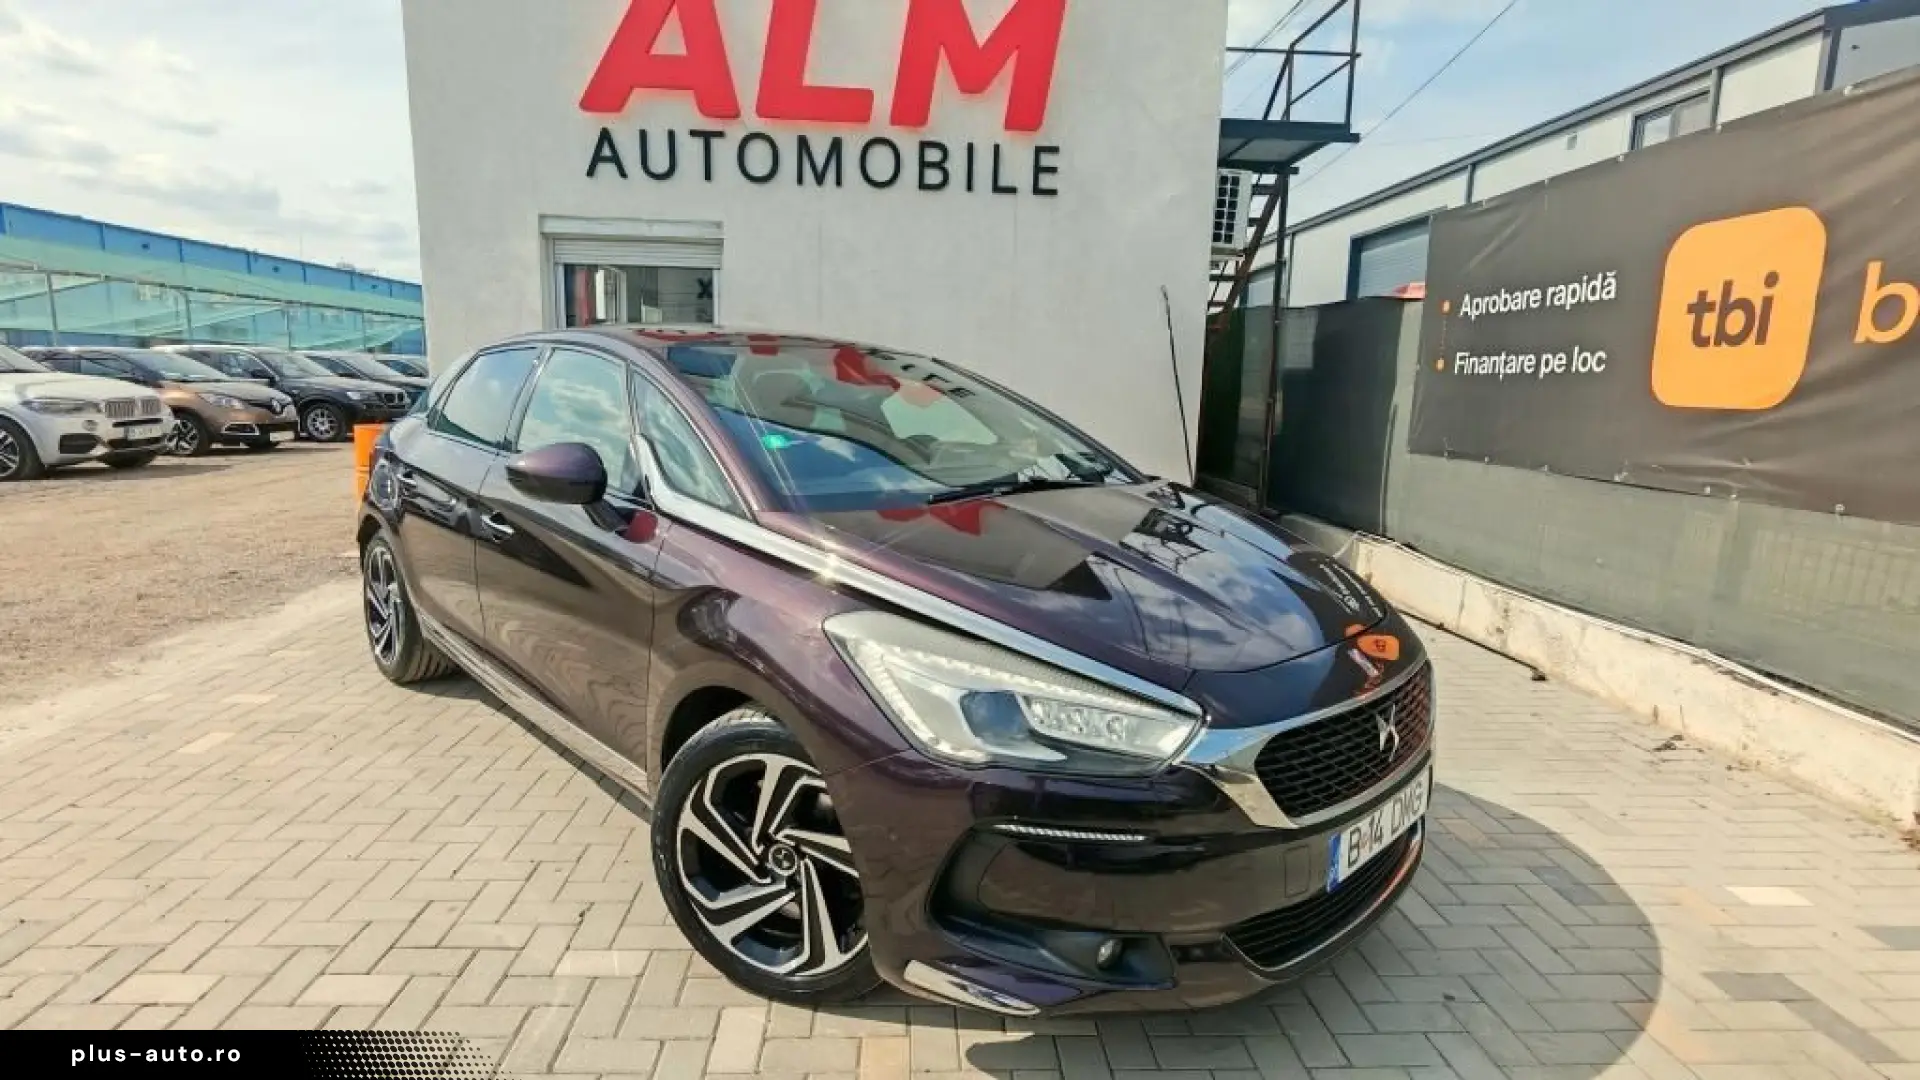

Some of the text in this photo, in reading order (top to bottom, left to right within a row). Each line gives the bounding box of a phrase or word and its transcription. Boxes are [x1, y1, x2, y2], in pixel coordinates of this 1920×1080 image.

[579, 0, 1066, 132] ALM
[586, 126, 1061, 196] AUTOMOBILE
[1458, 270, 1617, 321] Aprobare rapidă
[1687, 269, 1780, 348] tbi
[1454, 345, 1608, 381] Finanțare pe loc
